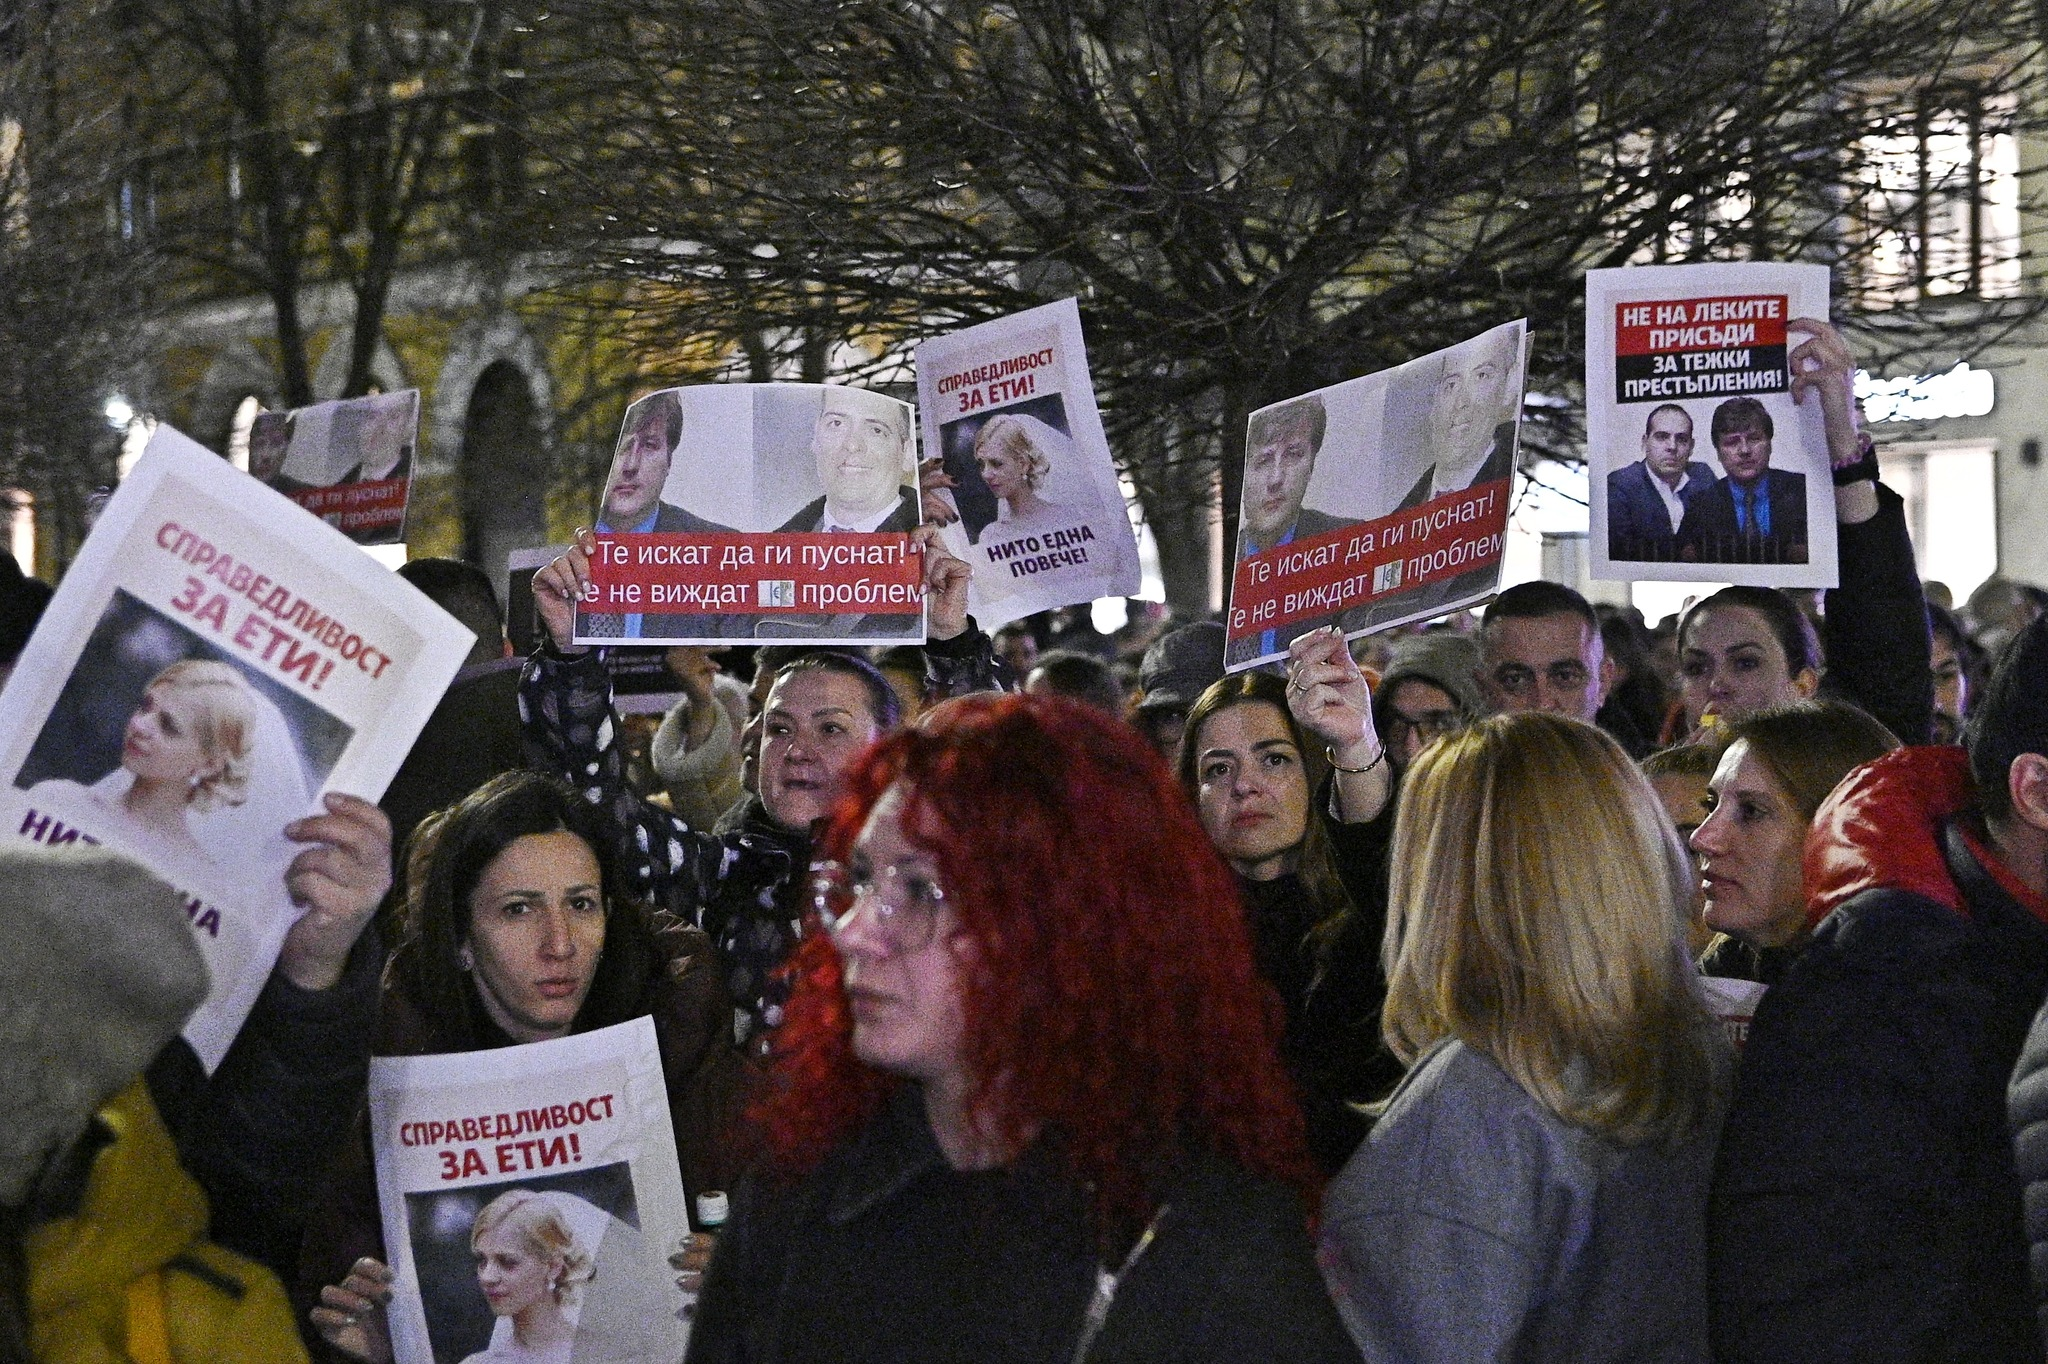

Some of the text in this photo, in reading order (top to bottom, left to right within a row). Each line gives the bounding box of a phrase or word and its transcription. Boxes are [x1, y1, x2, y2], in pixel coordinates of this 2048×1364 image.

[1623, 299, 1781, 328] НЕ НА ЛЕКИТЕ
[1650, 323, 1755, 350] ПРИСЪДИ
[937, 347, 1054, 395] СПРАВЕДЛИВОСТ
[1652, 349, 1750, 375] ЗА ТЕЖКИ
[958, 373, 1036, 413] ЗА ЕТИ!
[1624, 369, 1783, 398] ПРЕСТЪПЛЕНИЯ!
[597, 540, 905, 571] Те искат да ги пуснат!
[986, 525, 1096, 563] НИТО ЕДНА
[1248, 489, 1495, 586] Те искат да ги пуснат!
[1009, 547, 1090, 578] ПОВЕЧЕ!
[1252, 598, 1277, 624] не
[1284, 574, 1368, 614] виждат
[1407, 534, 1503, 582] проблем
[155, 521, 393, 680] СПРАВЕДЛИВОСТ
[610, 583, 642, 603] не
[651, 584, 750, 609] виждат
[802, 578, 920, 609] проблем
[169, 575, 337, 691] ЗА ЕТИ!
[400, 1094, 614, 1147] СПРАВЕДЛИВОСТ
[438, 1132, 583, 1181] ЗА ЕТИ!
